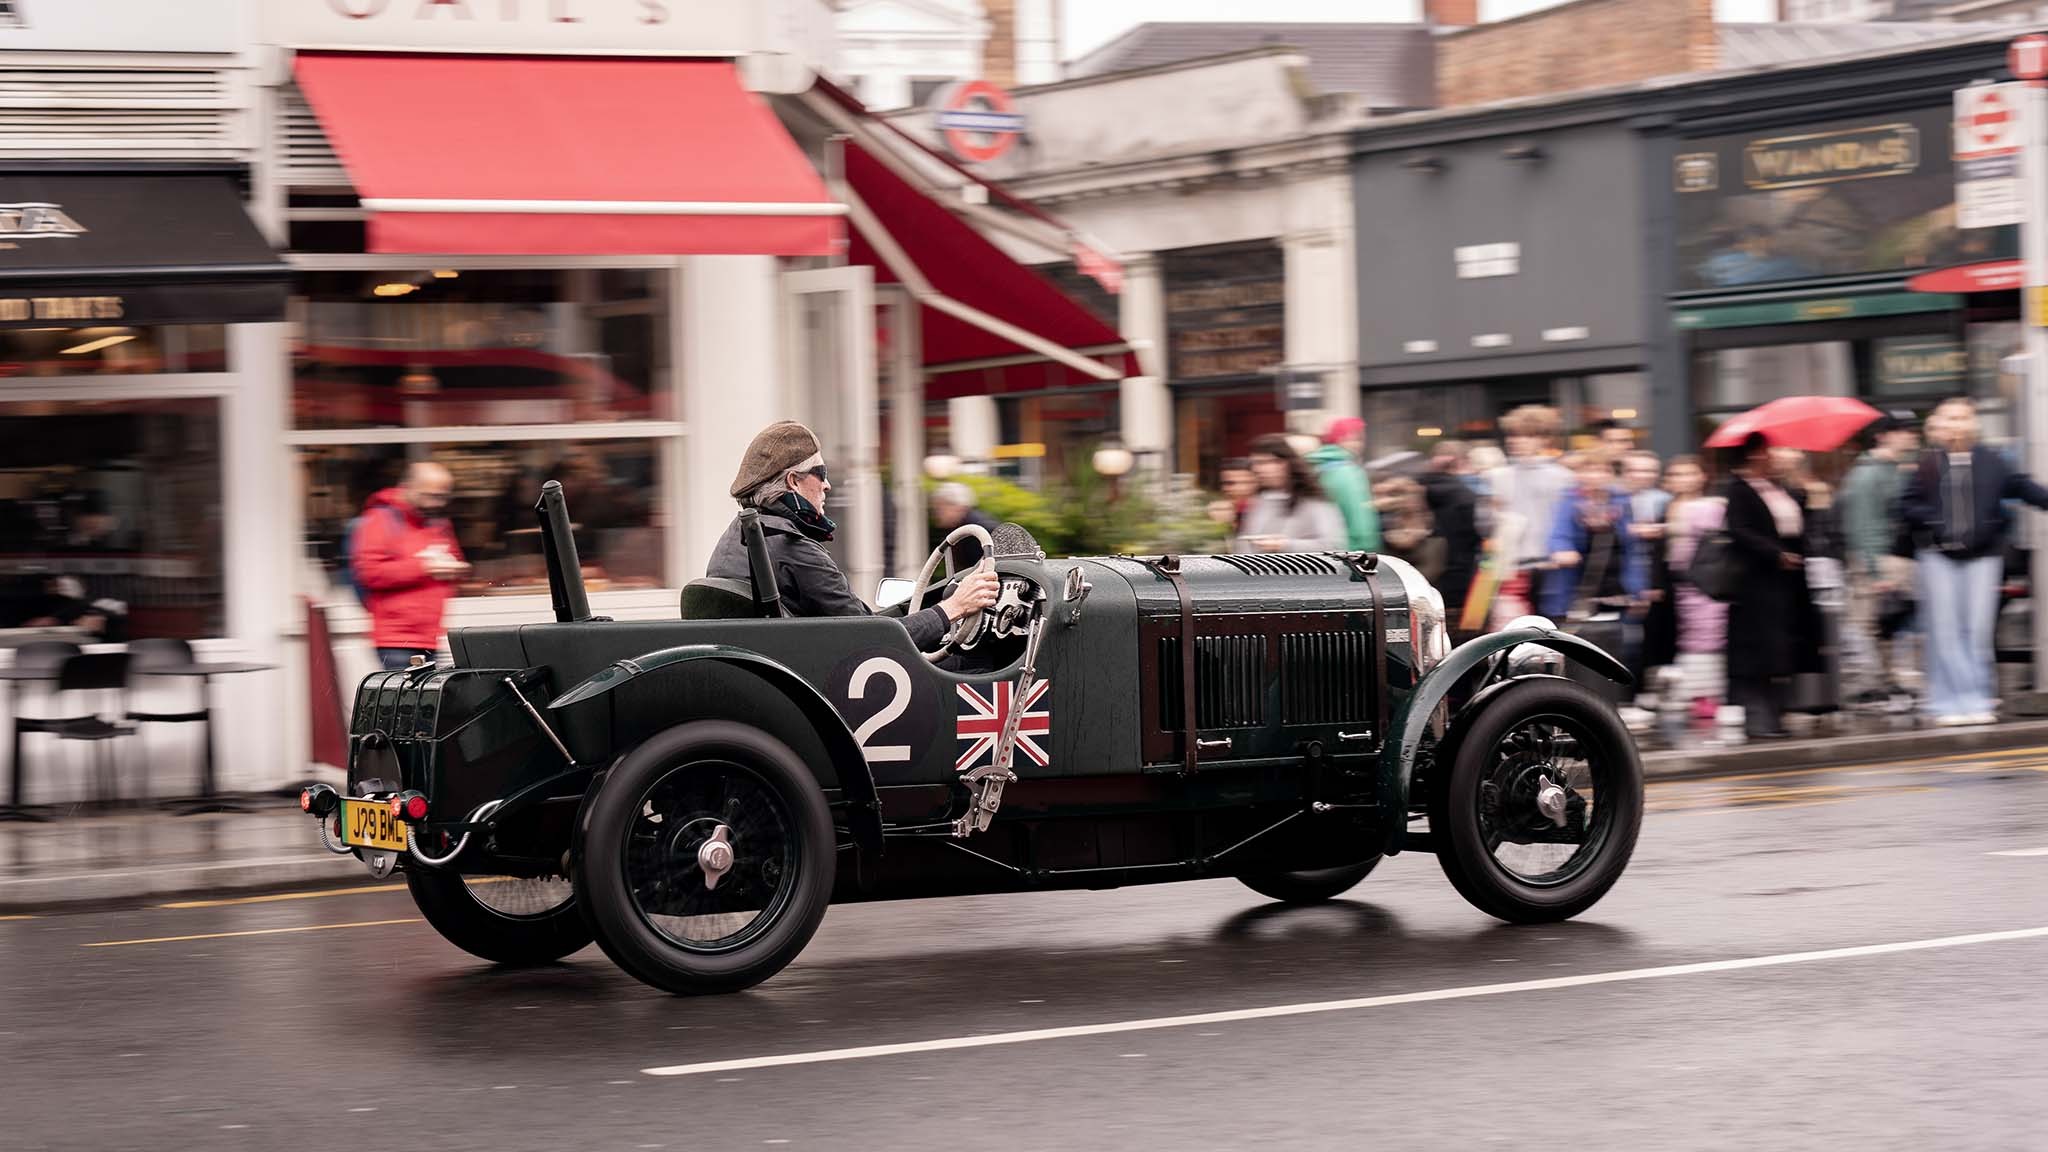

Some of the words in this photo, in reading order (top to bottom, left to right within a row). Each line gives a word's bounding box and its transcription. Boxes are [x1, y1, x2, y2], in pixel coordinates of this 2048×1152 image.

[847, 656, 912, 762] 2
[353, 807, 377, 840] J29
[380, 808, 403, 843] BML
